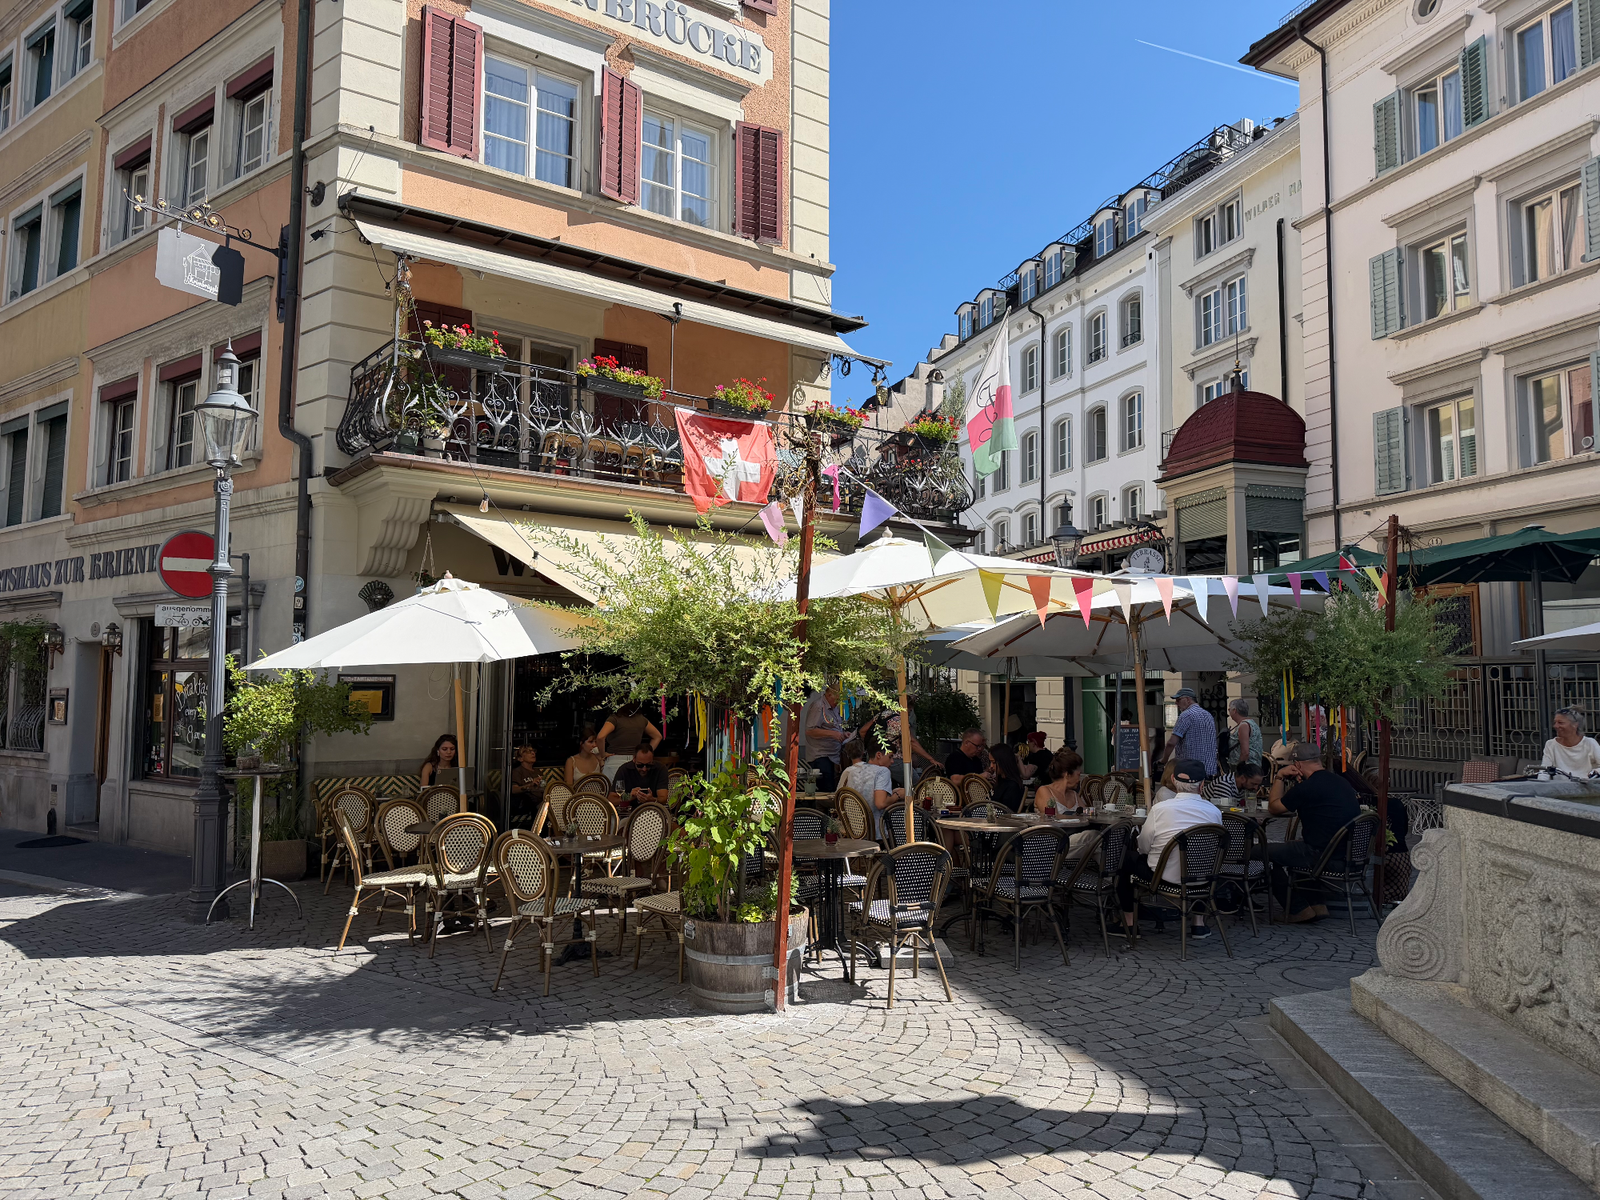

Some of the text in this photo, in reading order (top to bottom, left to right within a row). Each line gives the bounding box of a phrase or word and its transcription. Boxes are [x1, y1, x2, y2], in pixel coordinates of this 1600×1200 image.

[569, 0, 762, 75] BRÜCKE
[1288, 179, 1303, 197] MA
[1132, 548, 1163, 565] TERRASSE
[0, 543, 160, 592] TSHAUS ZUR KRIENB
[161, 605, 212, 614] ausgenomm
[186, 724, 194, 744] 8
